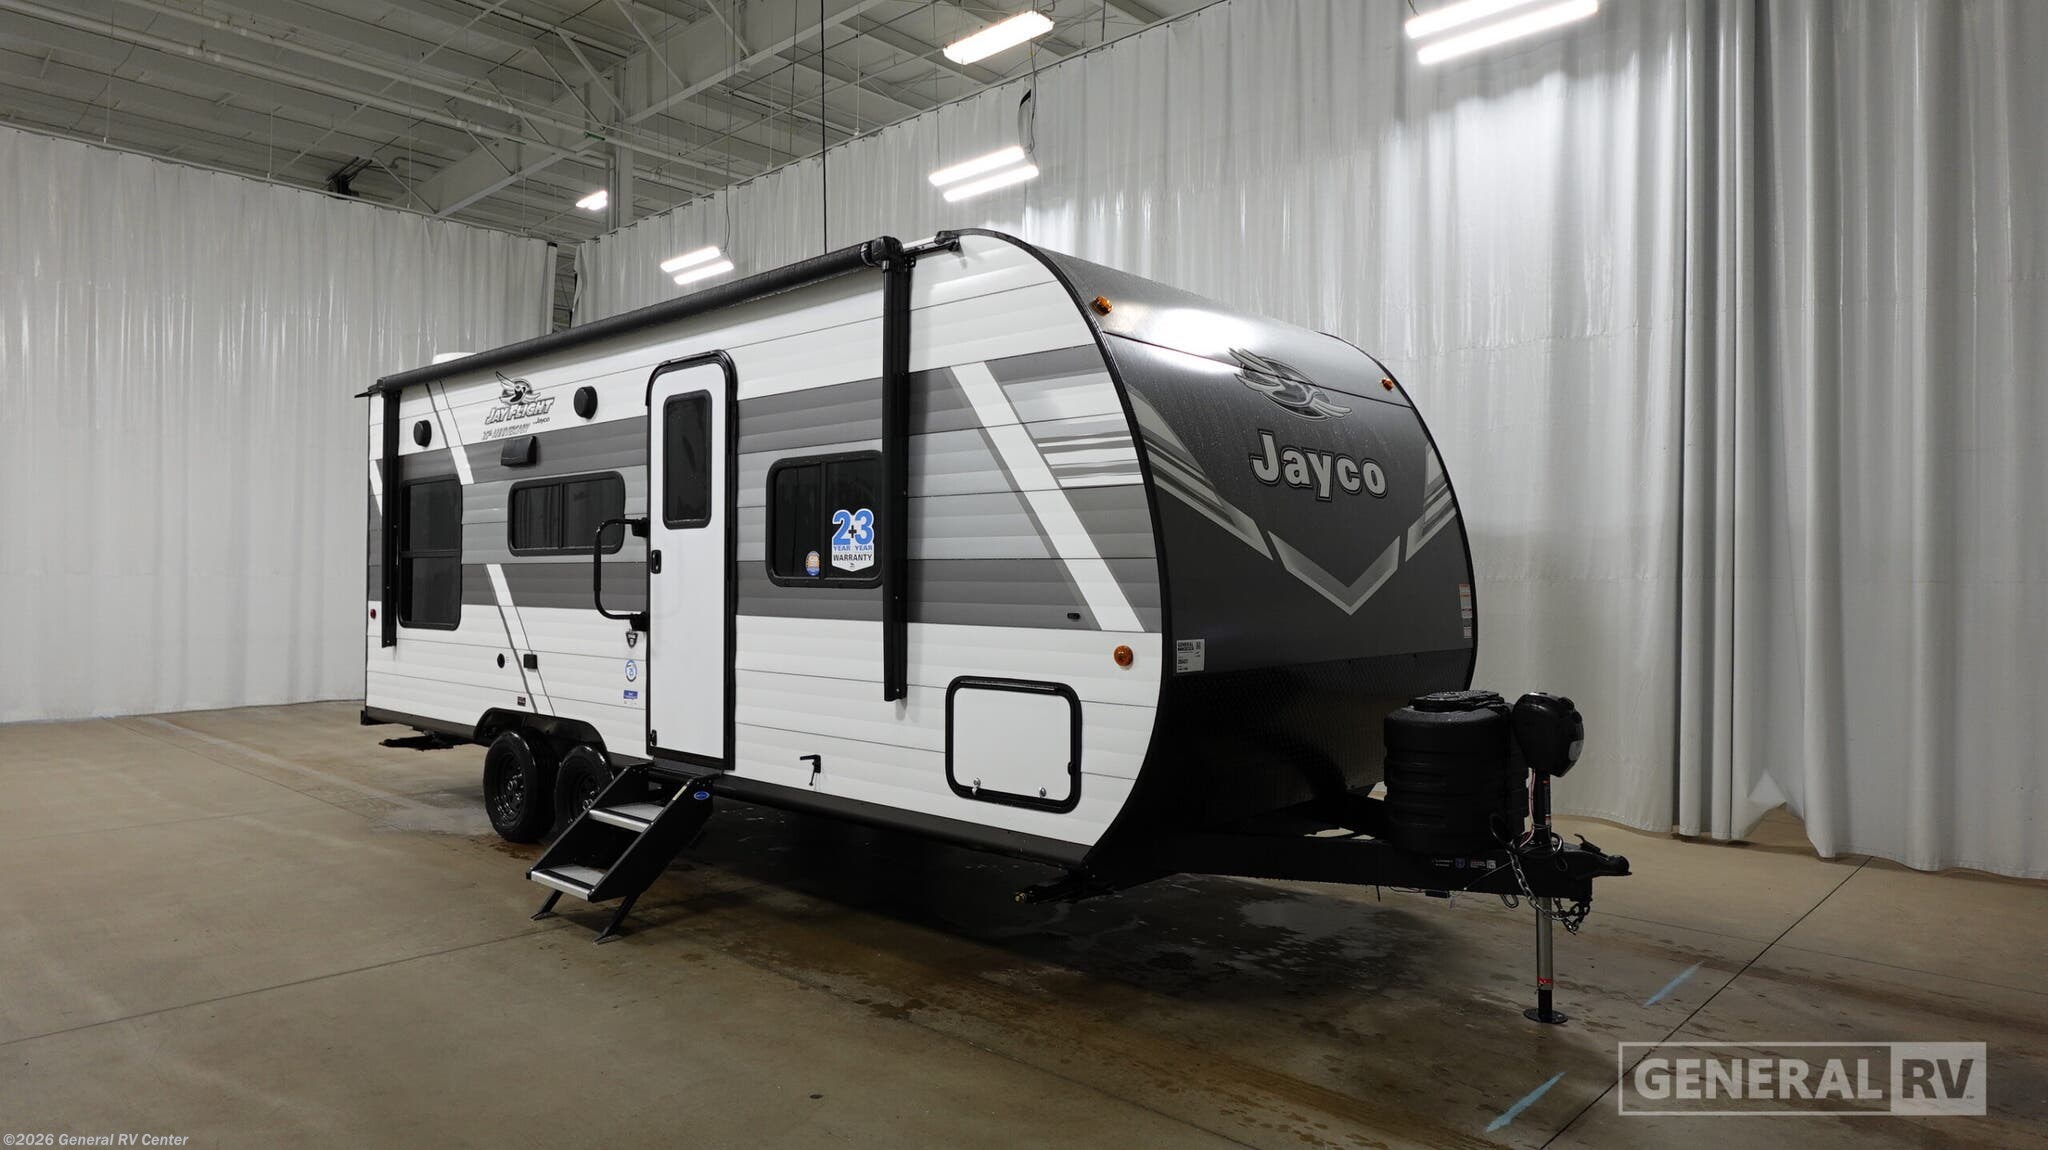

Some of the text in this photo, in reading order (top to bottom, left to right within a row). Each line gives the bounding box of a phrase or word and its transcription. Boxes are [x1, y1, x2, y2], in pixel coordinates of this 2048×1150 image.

[485, 397, 555, 425] JAY FLIGHT
[1250, 429, 1388, 501] Jayco
[833, 553, 872, 561] WARRANTY
